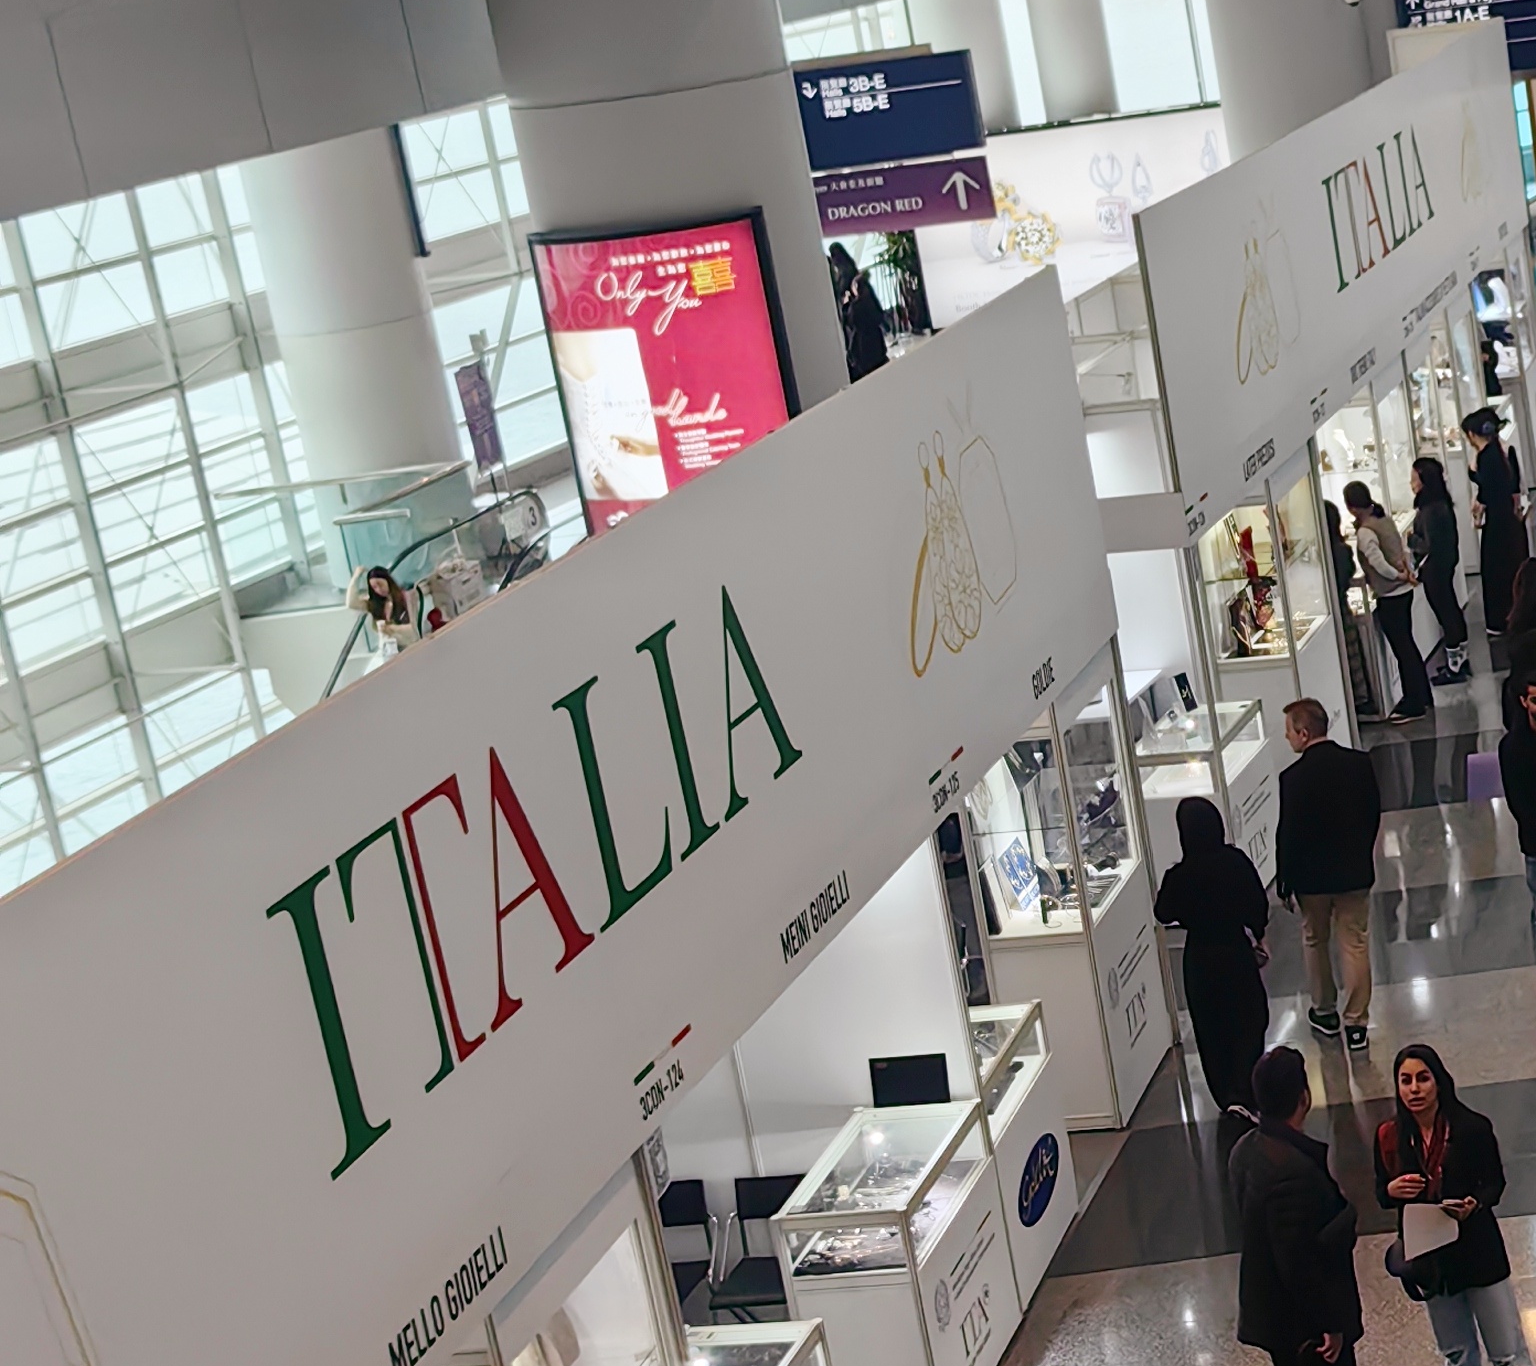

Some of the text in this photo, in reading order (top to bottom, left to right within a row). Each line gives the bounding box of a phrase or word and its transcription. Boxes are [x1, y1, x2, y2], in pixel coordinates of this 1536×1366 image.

[1454, 5, 1490, 23] 1A-E
[849, 73, 886, 93] 3B-E
[853, 93, 890, 113] 5B-E
[827, 197, 923, 221] DRAGON RED
[1321, 123, 1436, 293] ITALIA
[595, 270, 703, 336] Only You
[265, 584, 803, 1181] ITALIA
[779, 869, 851, 964] MEINI GIOIELLI
[639, 1059, 685, 1122] 3CON-124
[444, 1225, 510, 1322] GIOIELLI
